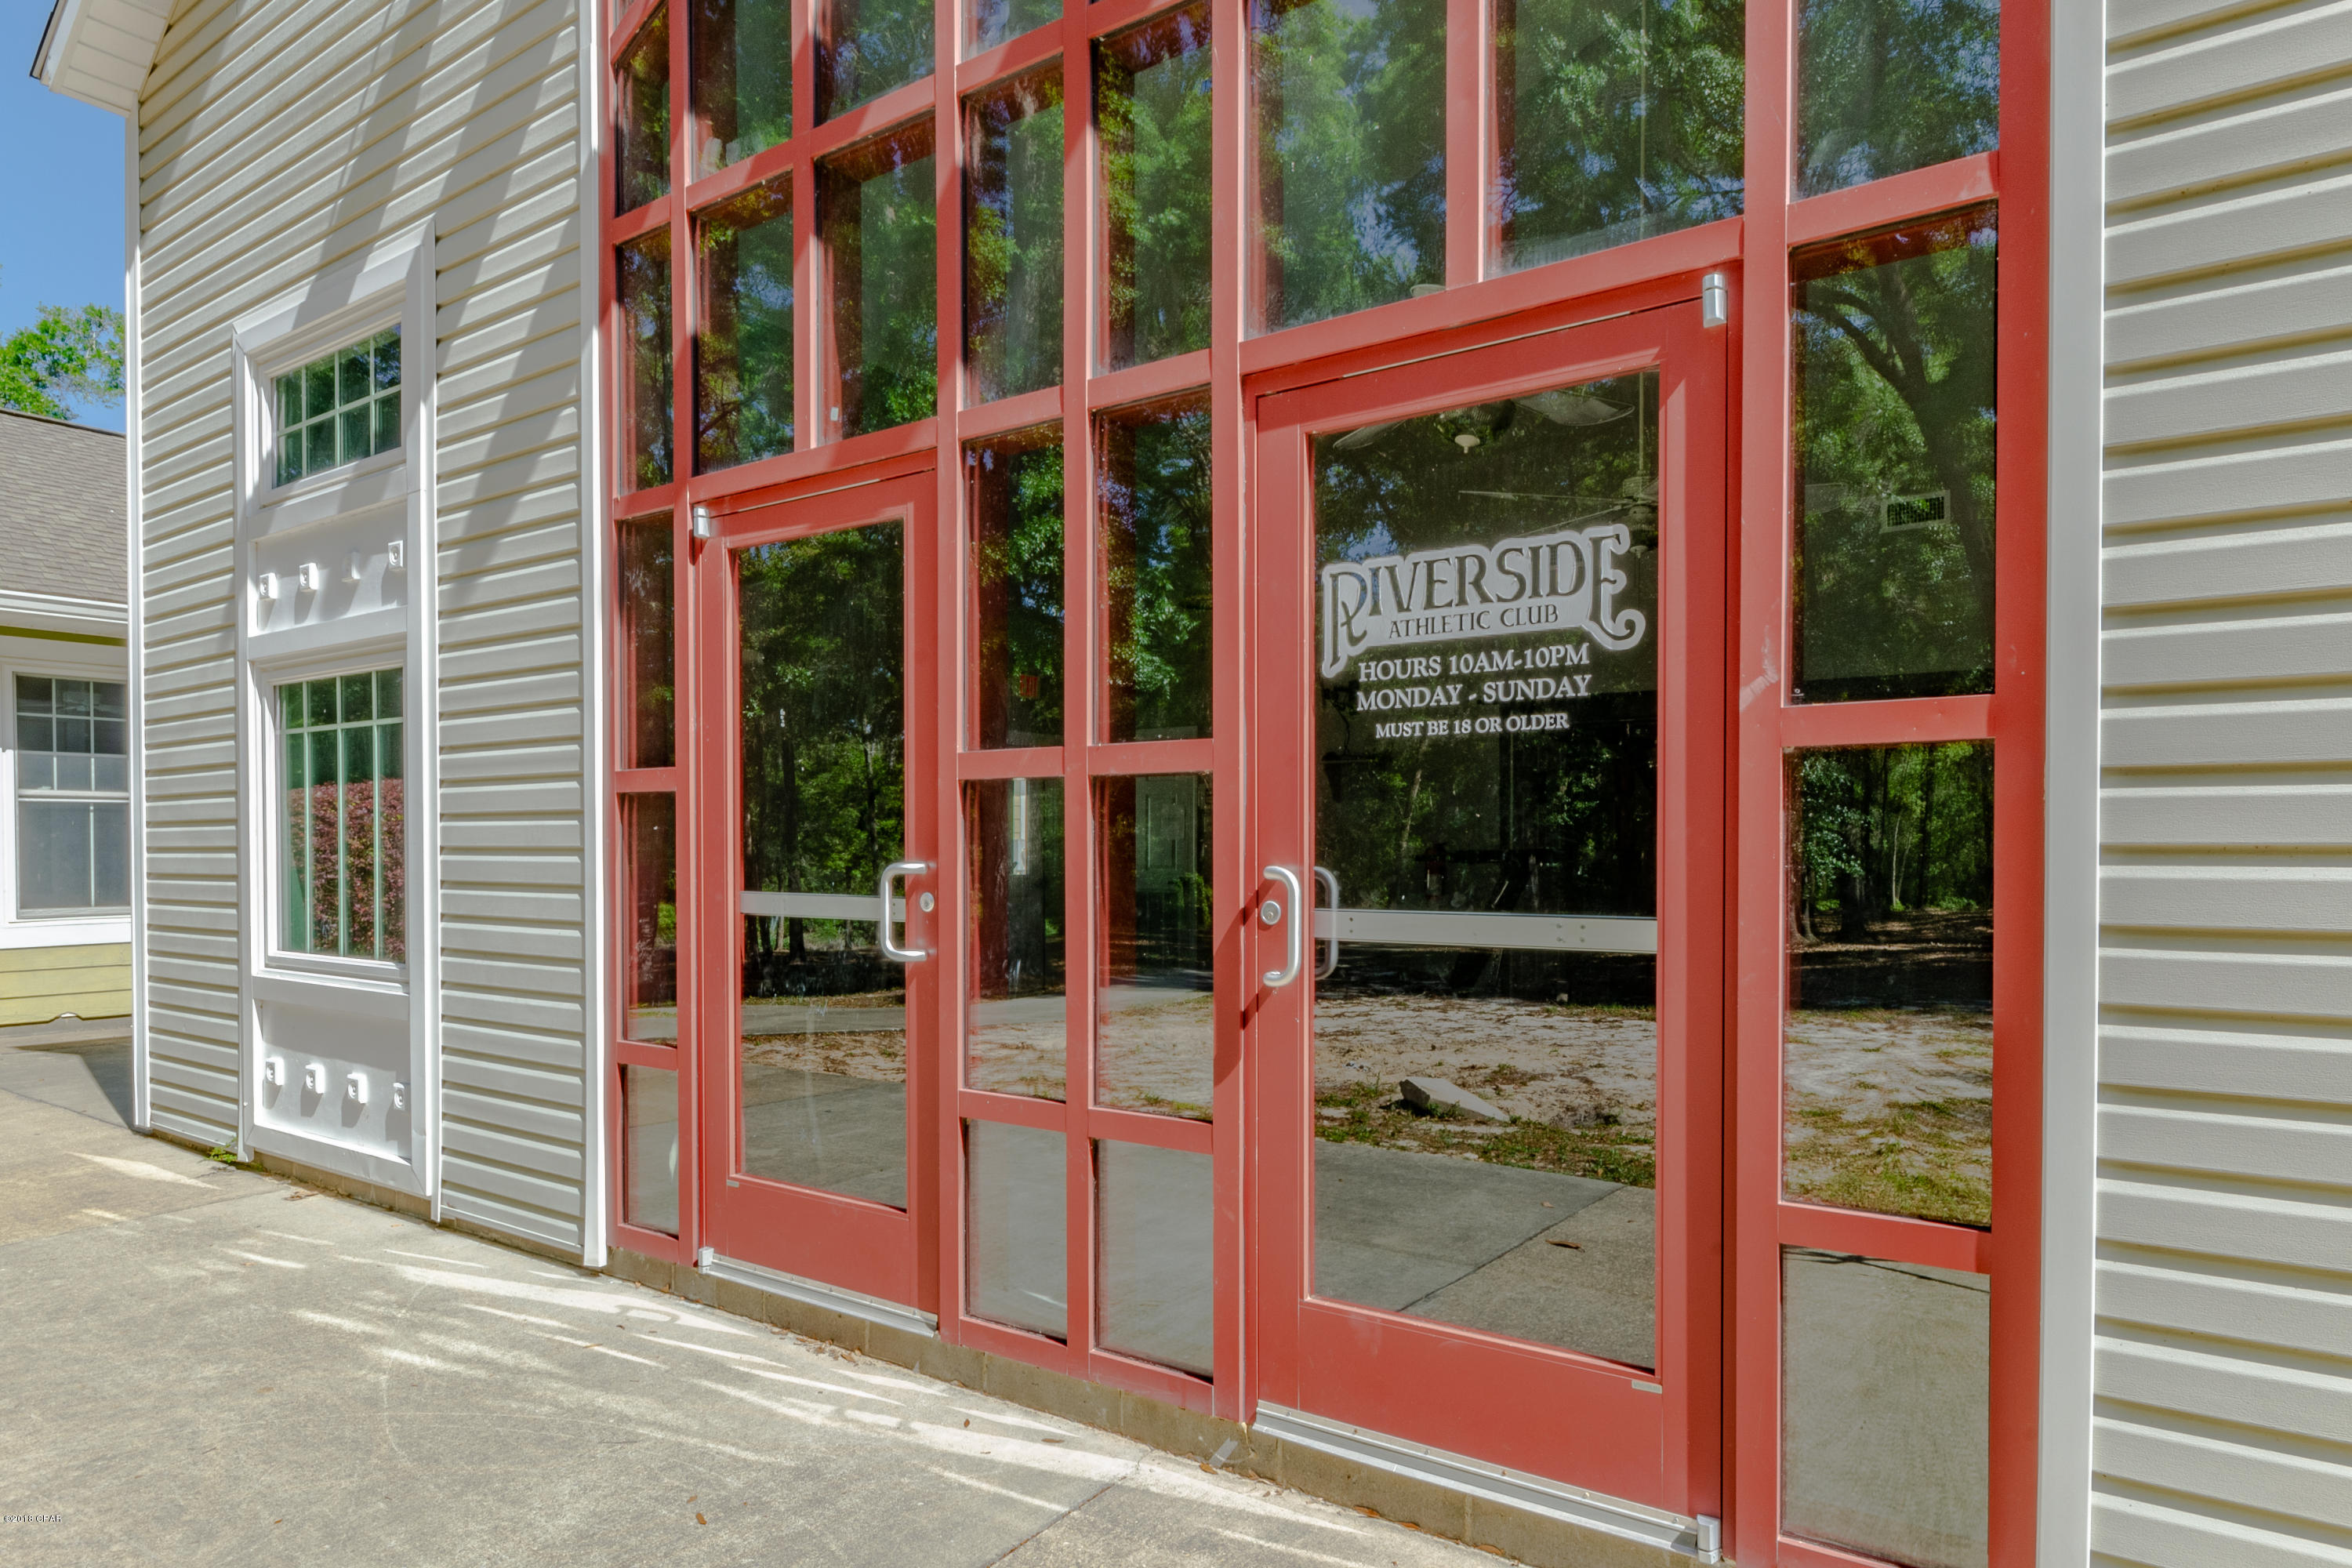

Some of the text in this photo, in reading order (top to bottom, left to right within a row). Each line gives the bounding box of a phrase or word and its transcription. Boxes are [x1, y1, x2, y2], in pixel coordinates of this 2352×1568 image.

[1329, 533, 1635, 666] RIVERSIDE
[1389, 604, 1559, 639] ATHLETIC CLUB
[1358, 642, 1590, 682] HOURS 10AM-10PM
[1356, 684, 1464, 711] MONDAY
[1483, 674, 1592, 703] SUNDAY
[1375, 713, 1570, 739] MUST BE 18 OR OLDER
